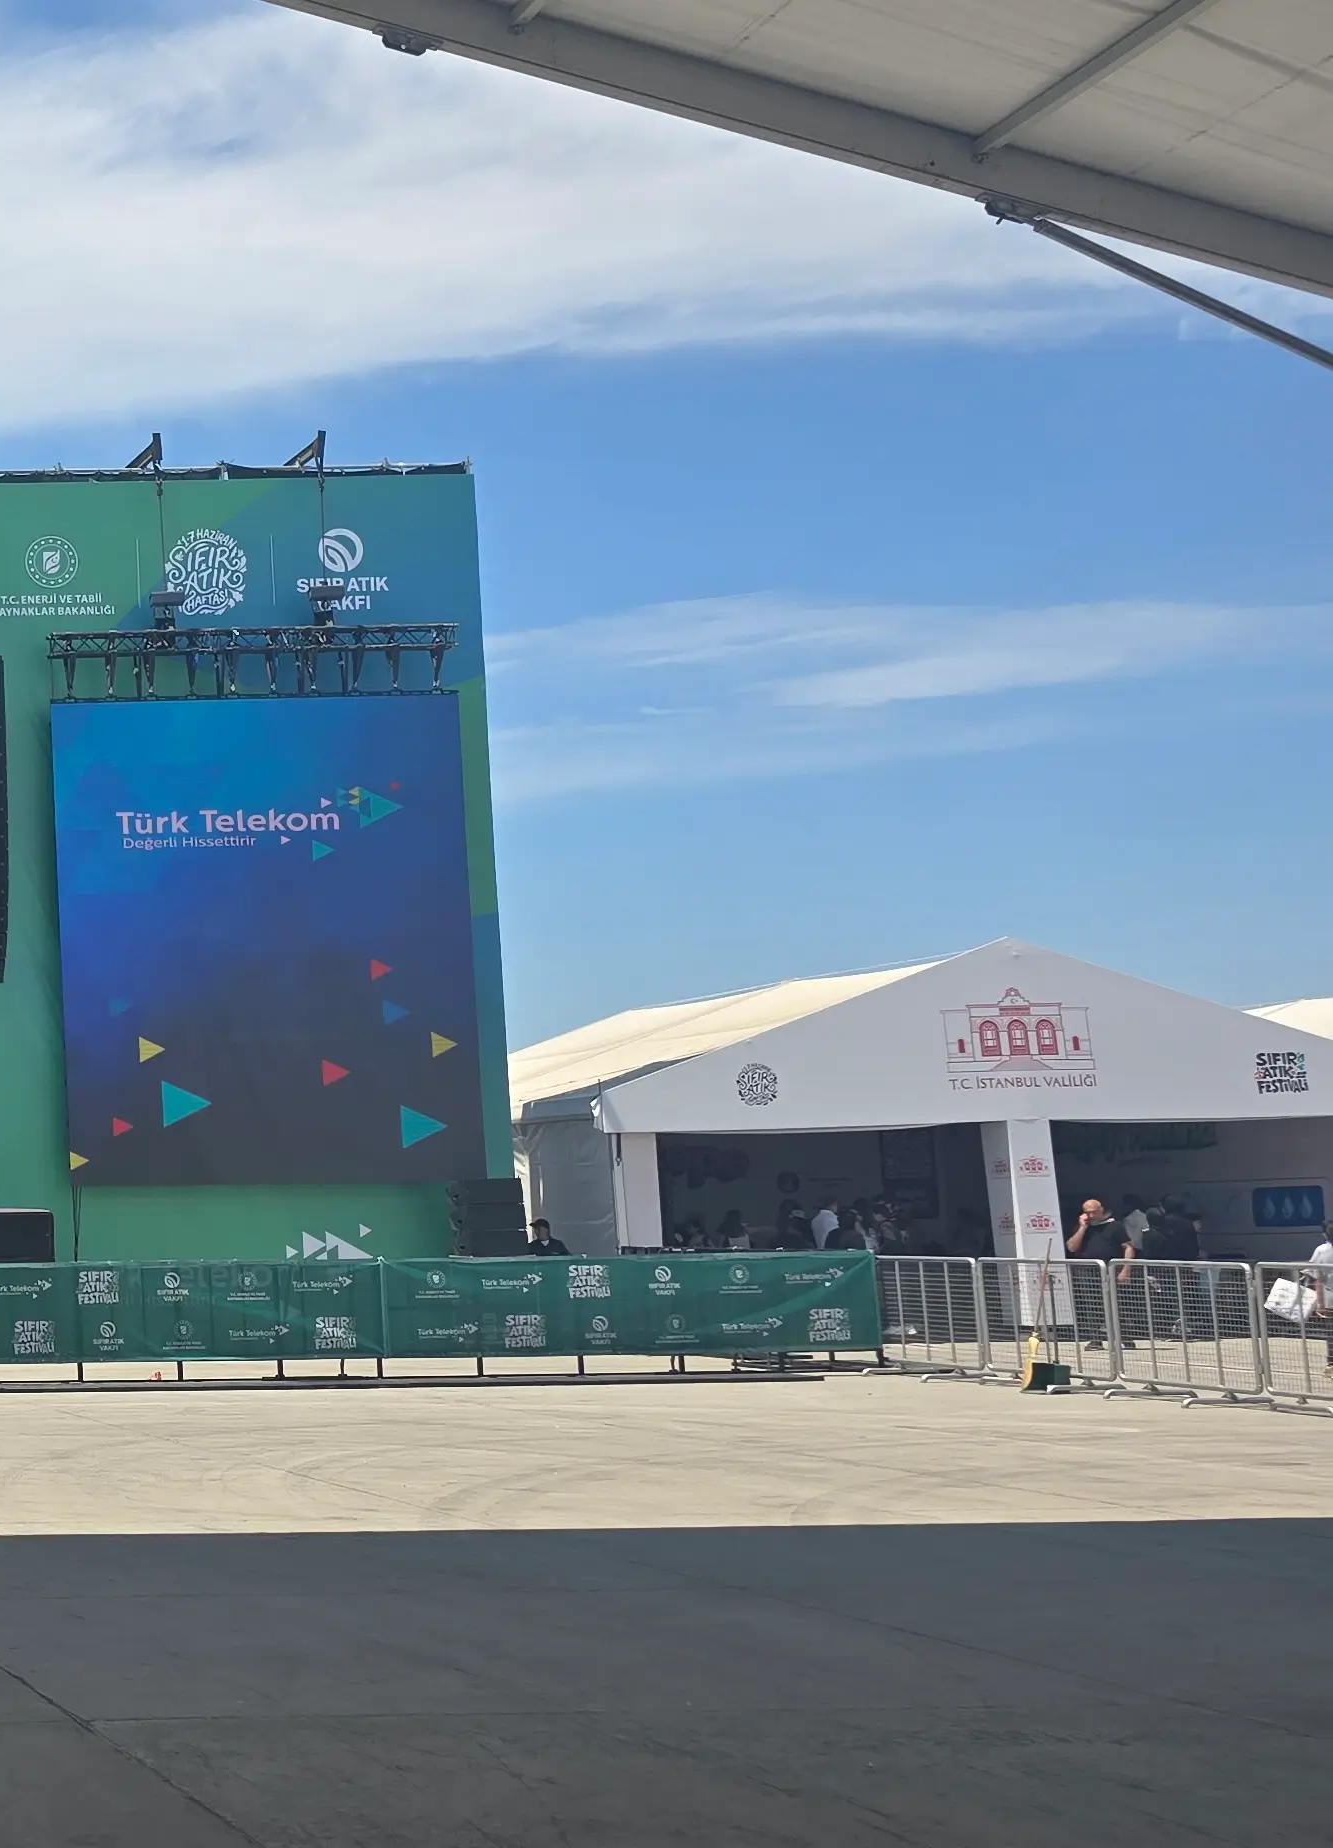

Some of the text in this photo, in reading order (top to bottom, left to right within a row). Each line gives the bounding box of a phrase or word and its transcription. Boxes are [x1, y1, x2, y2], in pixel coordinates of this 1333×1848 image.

[197, 528, 237, 549] HAZİRAN
[169, 546, 240, 583] SIFIR
[176, 568, 243, 595] ATIK
[347, 577, 389, 591] ATIK
[0, 592, 102, 605] T.C. ENERJİ VE TABİİ
[58, 605, 115, 617] BAKANLIĞI
[115, 809, 340, 835] Türk Telekom
[123, 835, 256, 851] Değerli Hissettirir
[1256, 1052, 1297, 1066] SIFIR
[1263, 1066, 1294, 1079] ATIK
[976, 1076, 1041, 1089] İSTANBUL
[78, 1271, 112, 1283] SIFIR
[568, 1265, 603, 1277] SIFIR
[82, 1282, 109, 1293] ATIK
[310, 1280, 340, 1288] Telekom
[482, 1278, 529, 1287] Türk Telekom
[572, 1276, 599, 1287] ATIK
[9, 1284, 39, 1292] Telekom
[505, 1314, 539, 1326] SIFIR
[809, 1308, 844, 1320] SIFIR
[14, 1320, 49, 1333] SIFIR
[315, 1316, 350, 1329] SIFIR
[246, 1329, 276, 1337] Telekom
[320, 1327, 346, 1338] ATIK
[417, 1327, 466, 1336] Türk Telekom
[509, 1325, 536, 1337] ATIK
[18, 1332, 44, 1343] ATIK
